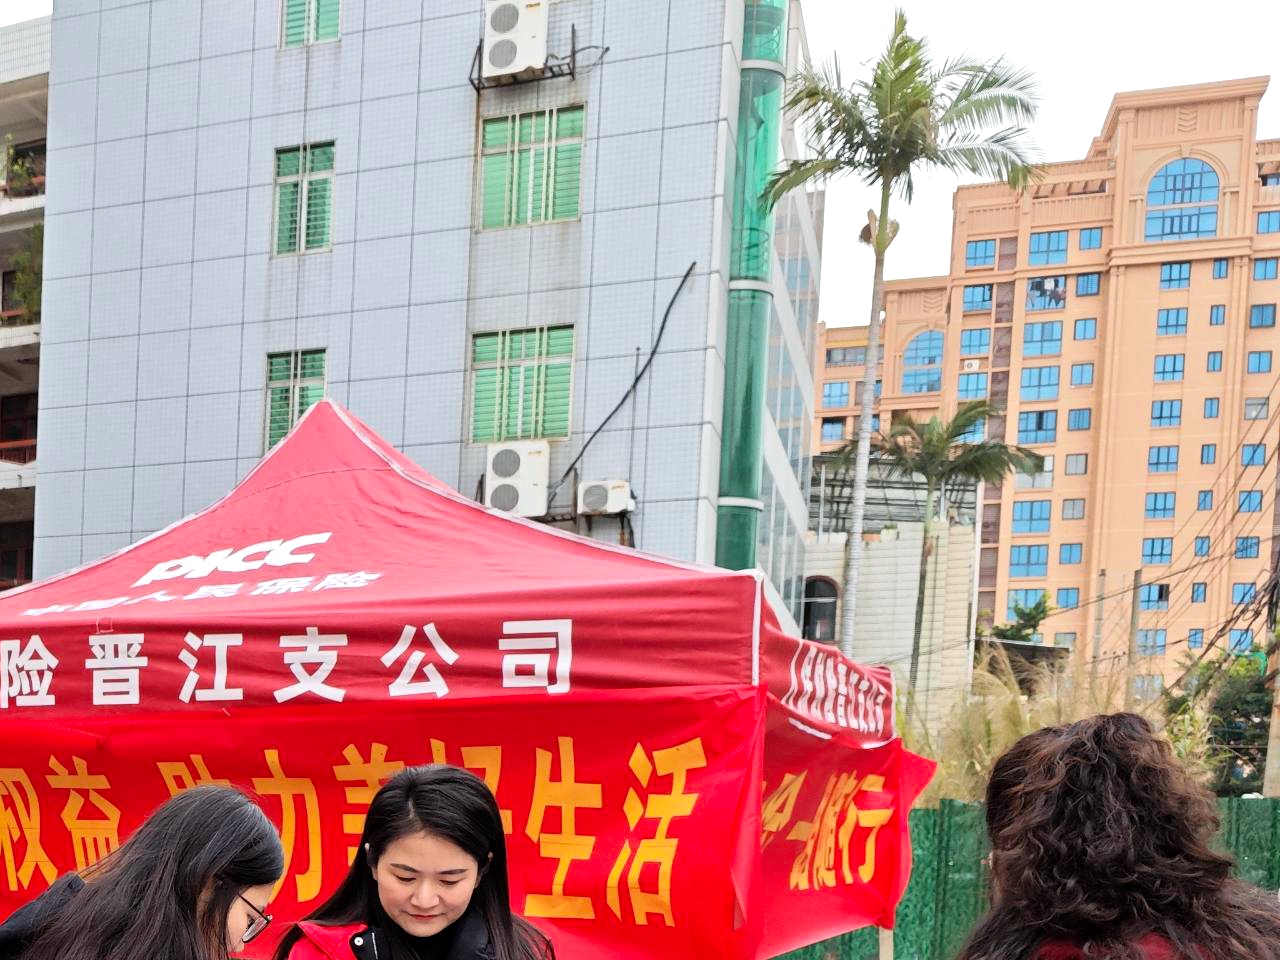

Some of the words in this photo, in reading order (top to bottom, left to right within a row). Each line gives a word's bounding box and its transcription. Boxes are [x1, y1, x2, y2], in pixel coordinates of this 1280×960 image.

[130, 532, 332, 588] PICC
[156, 736, 706, 927] 力生活
